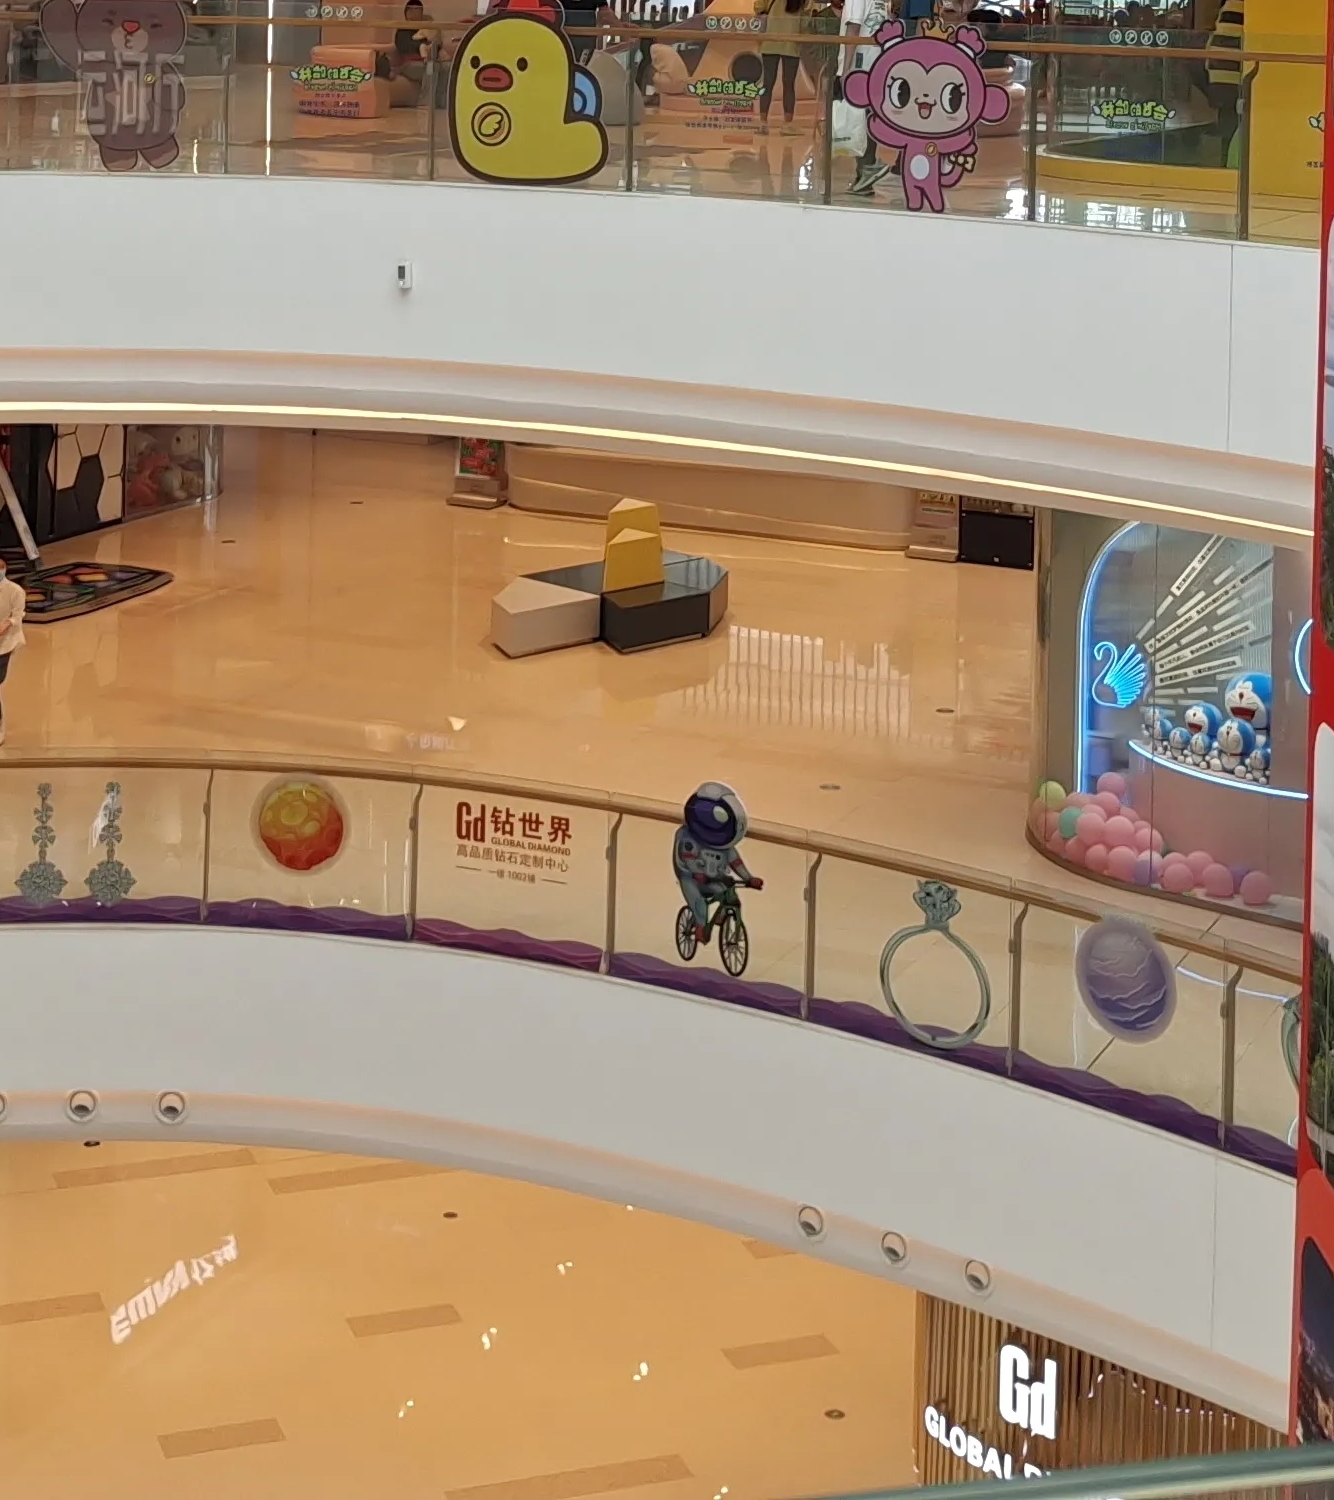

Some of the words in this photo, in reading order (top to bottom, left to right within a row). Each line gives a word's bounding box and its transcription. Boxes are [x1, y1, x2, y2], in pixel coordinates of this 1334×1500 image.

[456, 801, 486, 842] Gd
[490, 806, 573, 845] 钻世界
[491, 836, 527, 850] GLOBAL
[528, 842, 571, 856] DIAMOND
[999, 1343, 1058, 1440] Gd
